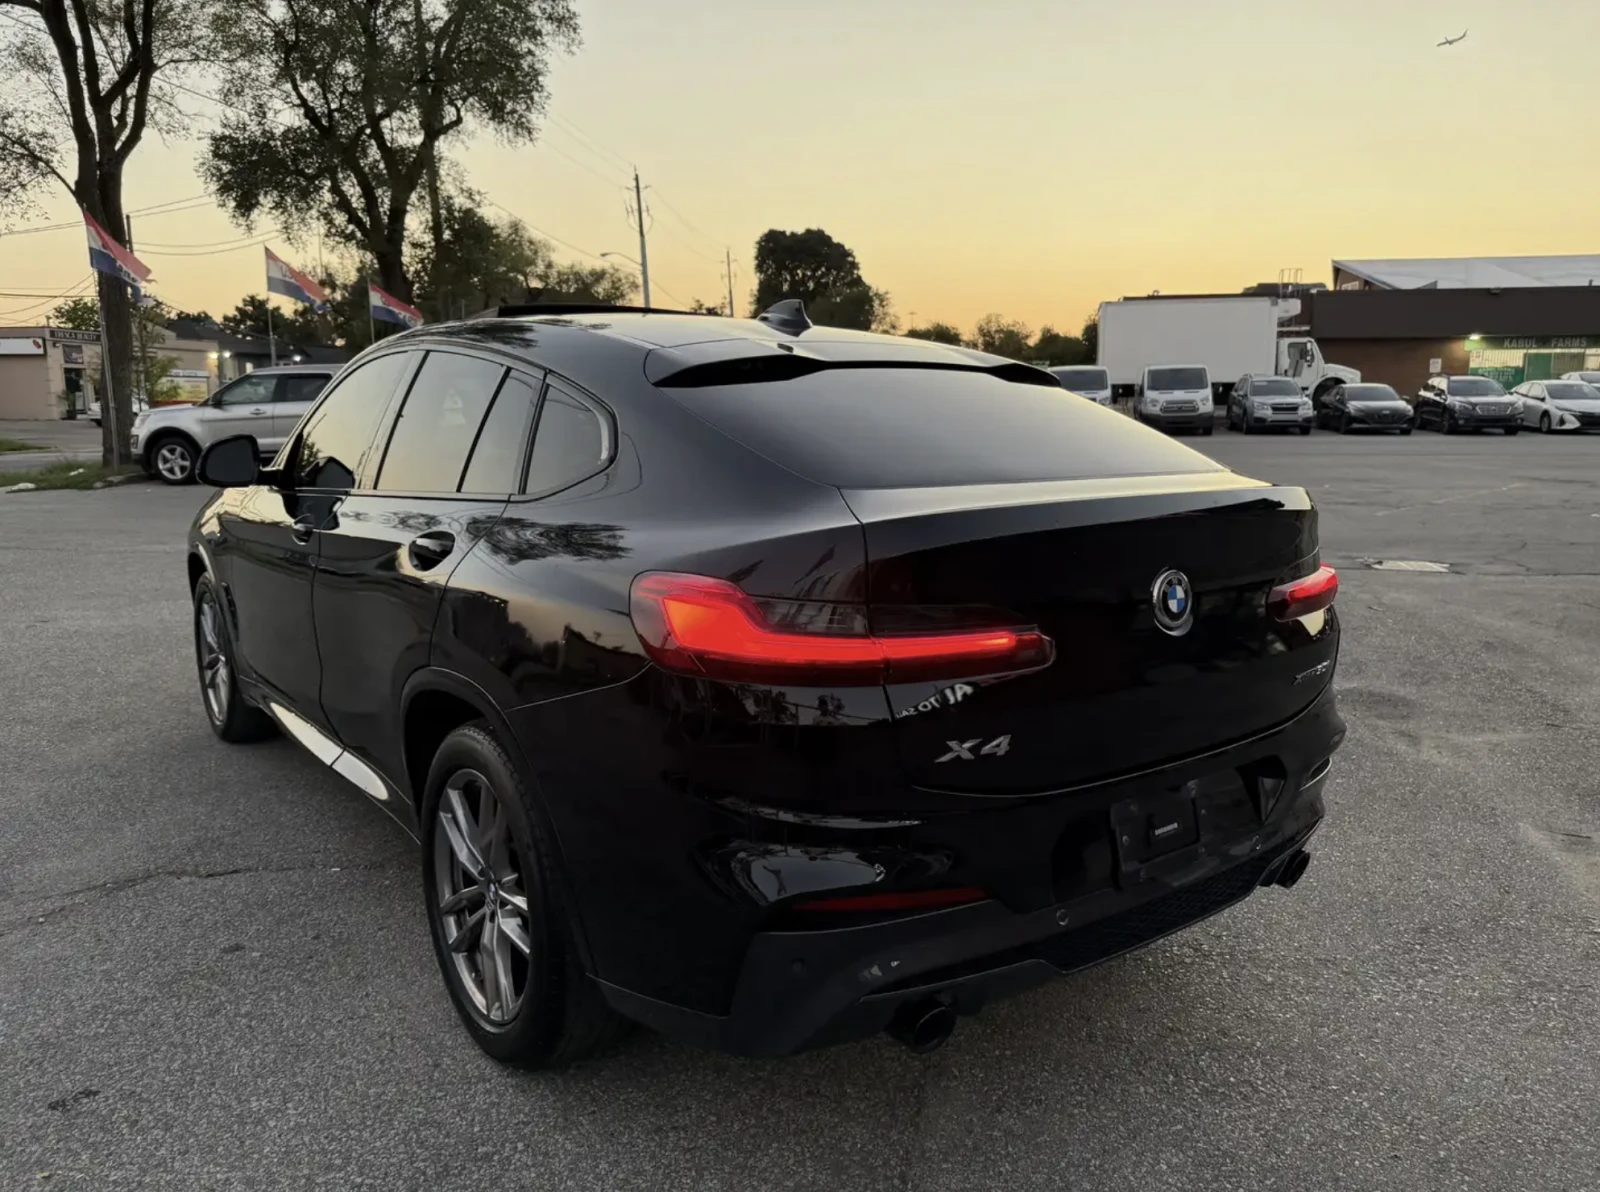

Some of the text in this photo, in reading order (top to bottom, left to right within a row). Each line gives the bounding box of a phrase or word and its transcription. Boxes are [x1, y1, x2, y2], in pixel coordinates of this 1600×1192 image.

[1503, 337, 1587, 348] KABUL FARMS
[934, 734, 1012, 763] X4
